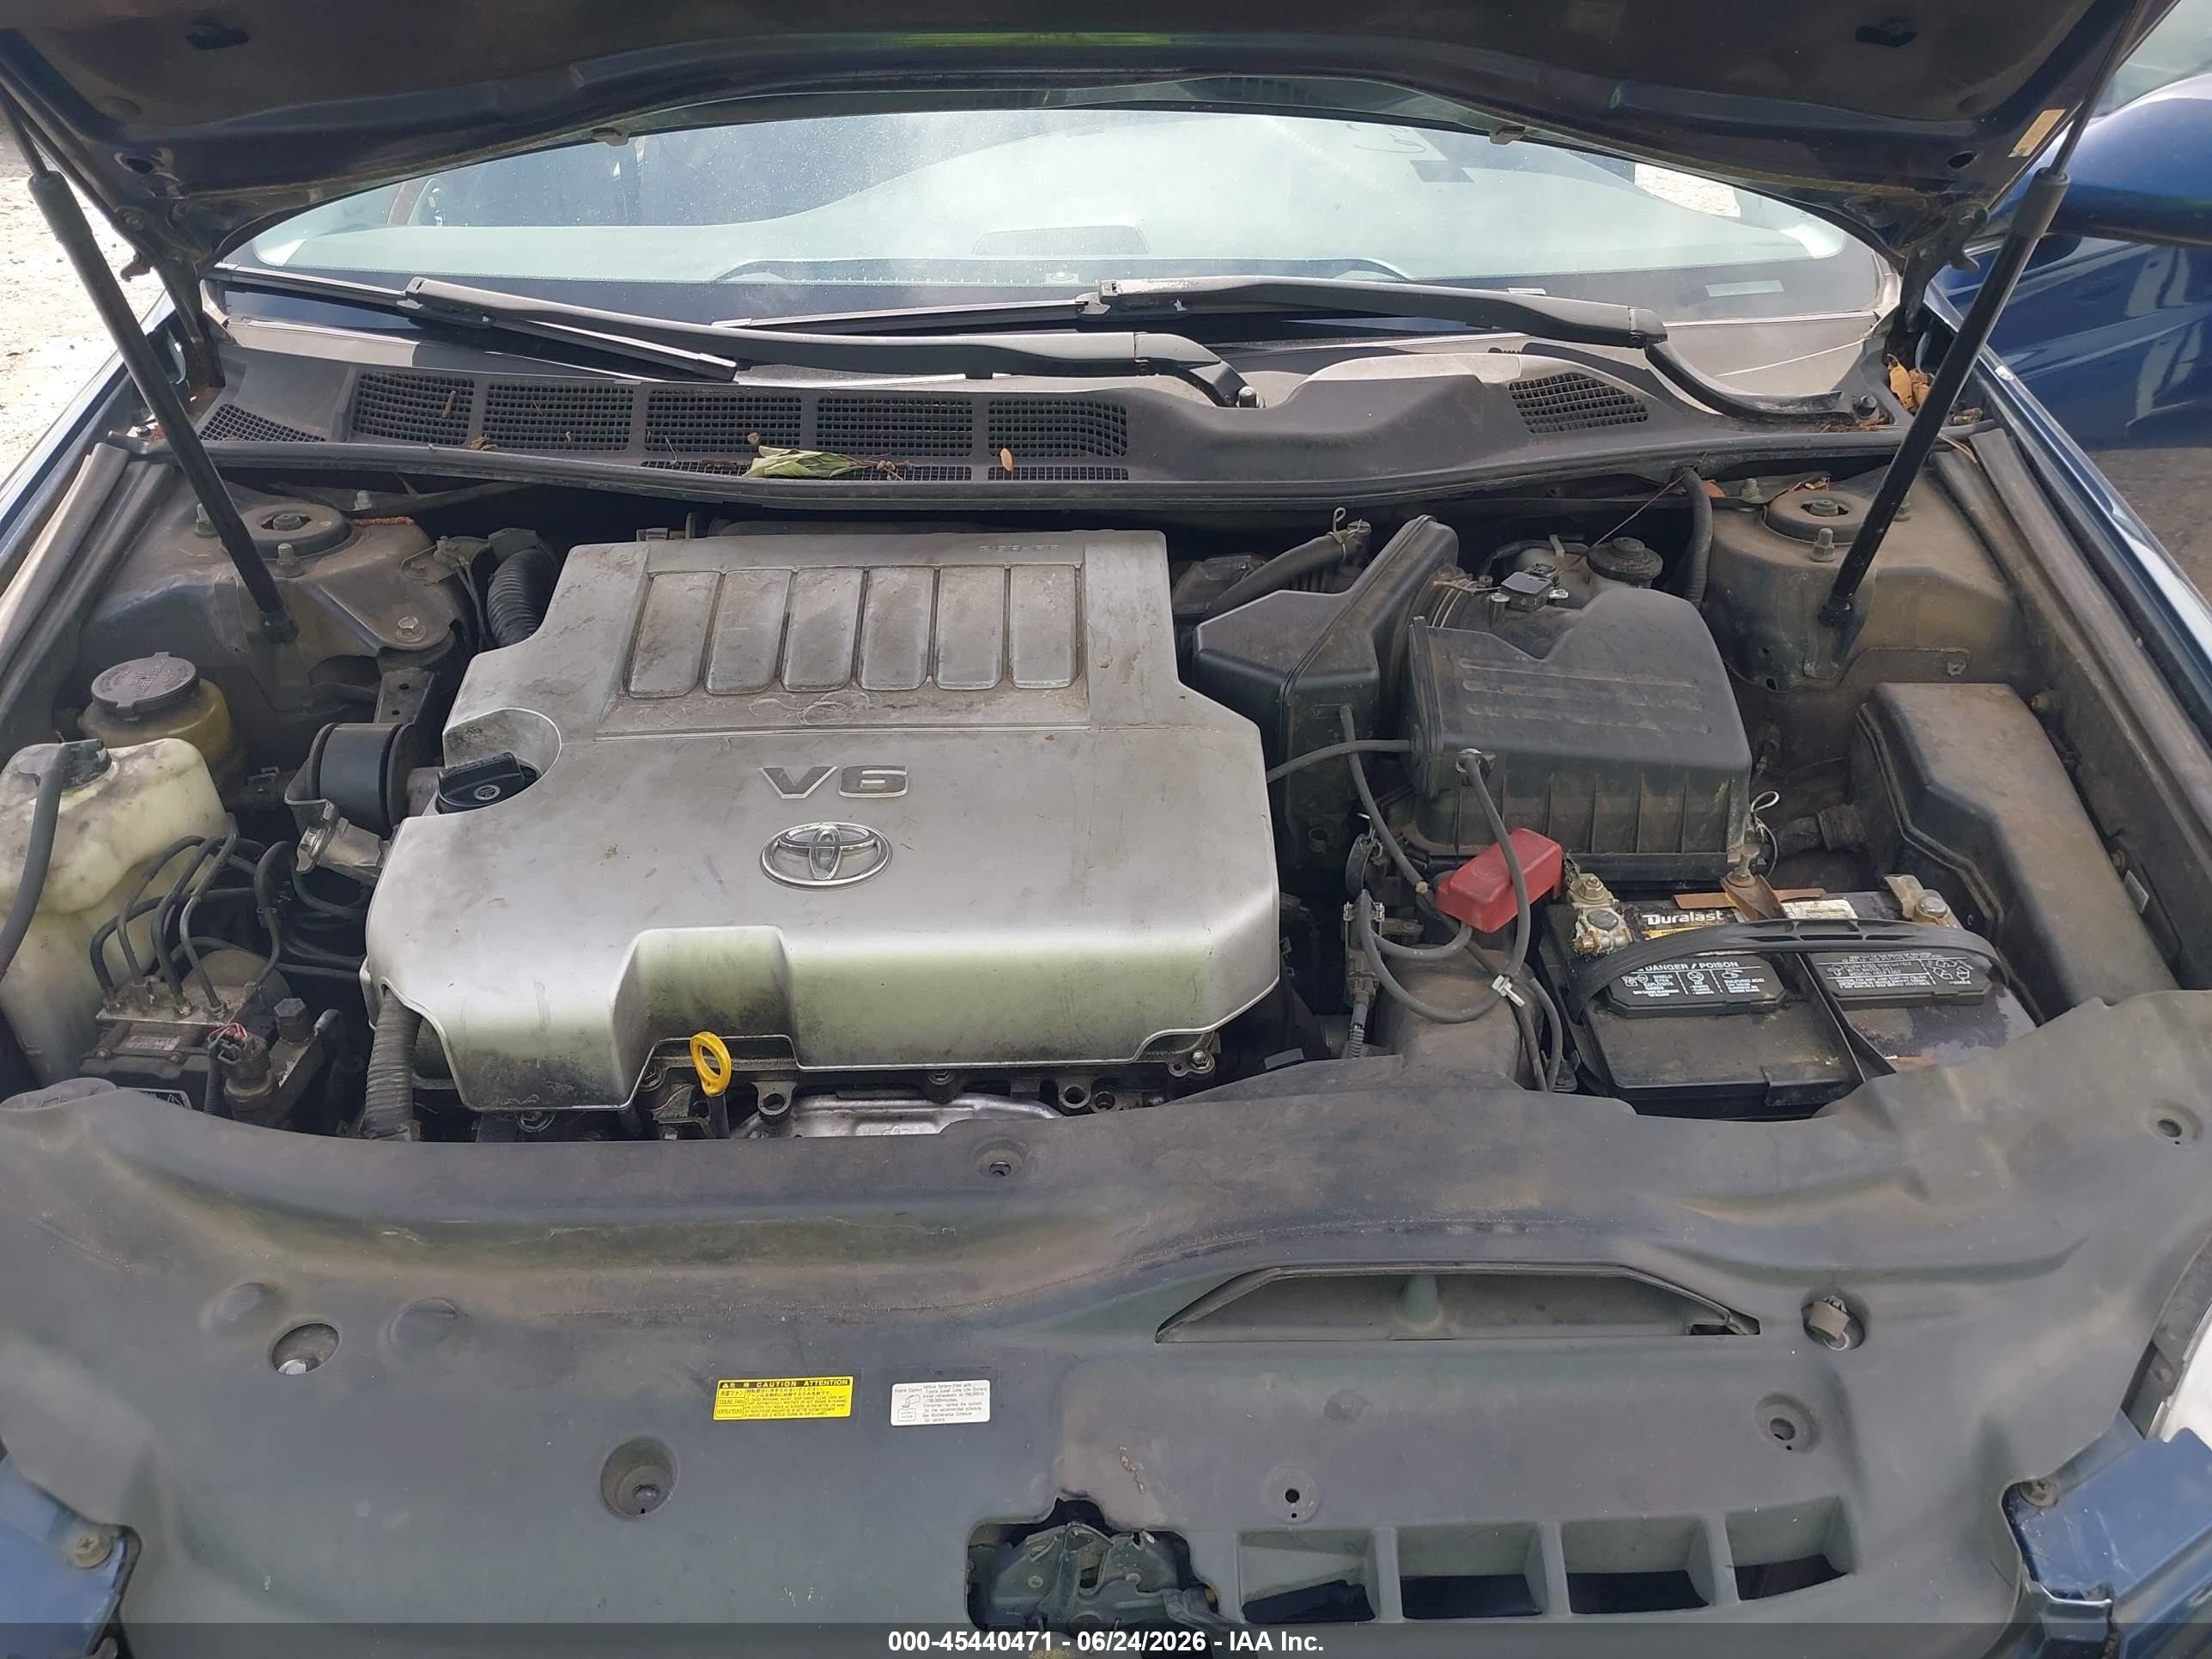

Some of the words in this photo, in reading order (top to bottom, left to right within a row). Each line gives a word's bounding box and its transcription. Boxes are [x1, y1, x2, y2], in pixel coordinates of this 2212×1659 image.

[759, 764, 908, 799] V6
[1642, 910, 1724, 926] Duralast
[1698, 961, 1739, 969] POISON
